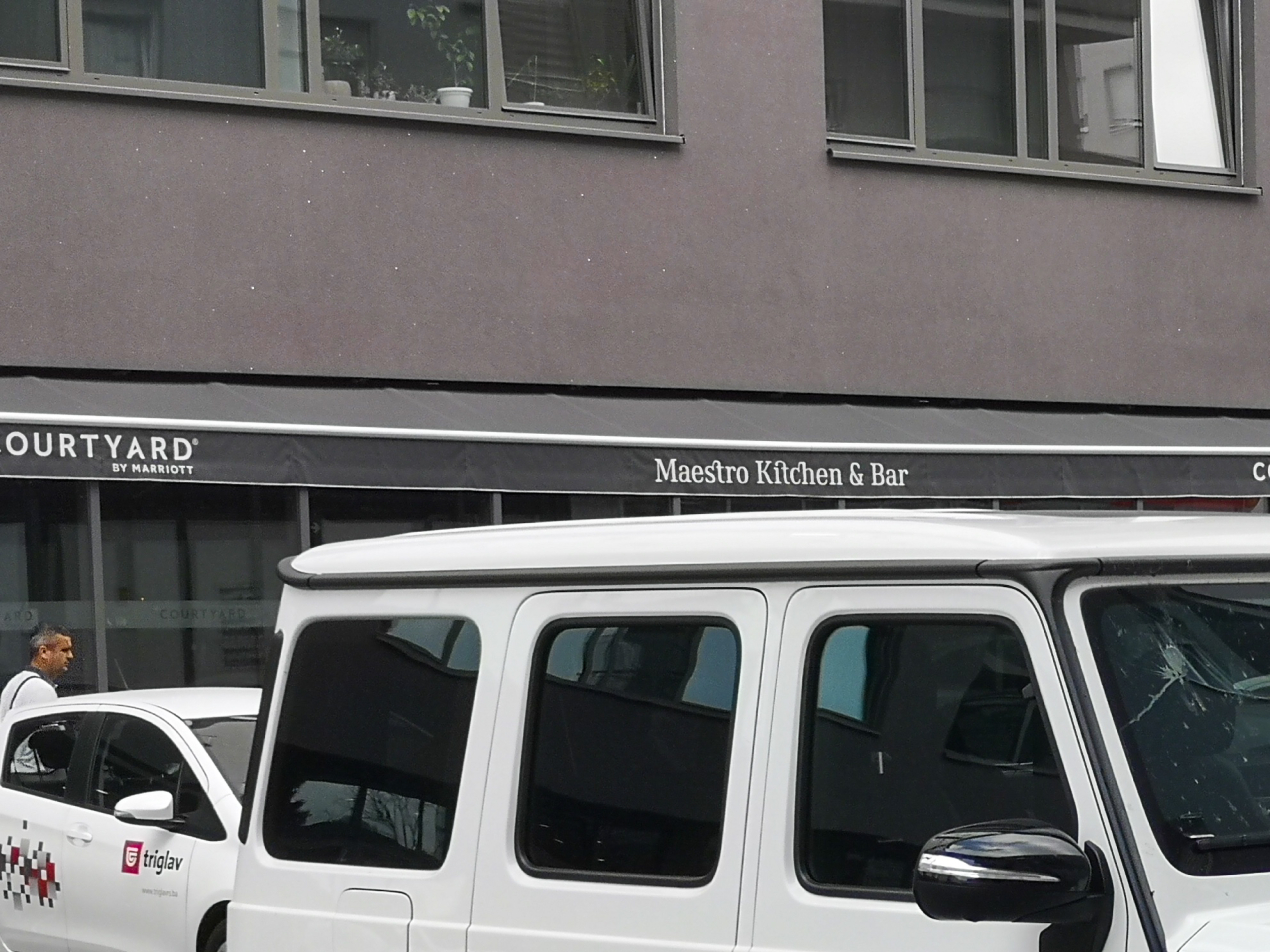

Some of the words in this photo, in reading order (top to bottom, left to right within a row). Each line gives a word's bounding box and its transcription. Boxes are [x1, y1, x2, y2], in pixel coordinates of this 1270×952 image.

[0, 431, 192, 461] OURTYARD
[112, 463, 127, 472] BY
[131, 464, 194, 475] MARRIOTT
[654, 458, 749, 484] Maestro
[755, 460, 843, 486] Kitchen
[849, 462, 865, 486] &
[870, 462, 909, 487] Bar
[160, 608, 246, 620] COURTYARD
[143, 850, 184, 875] triglav
